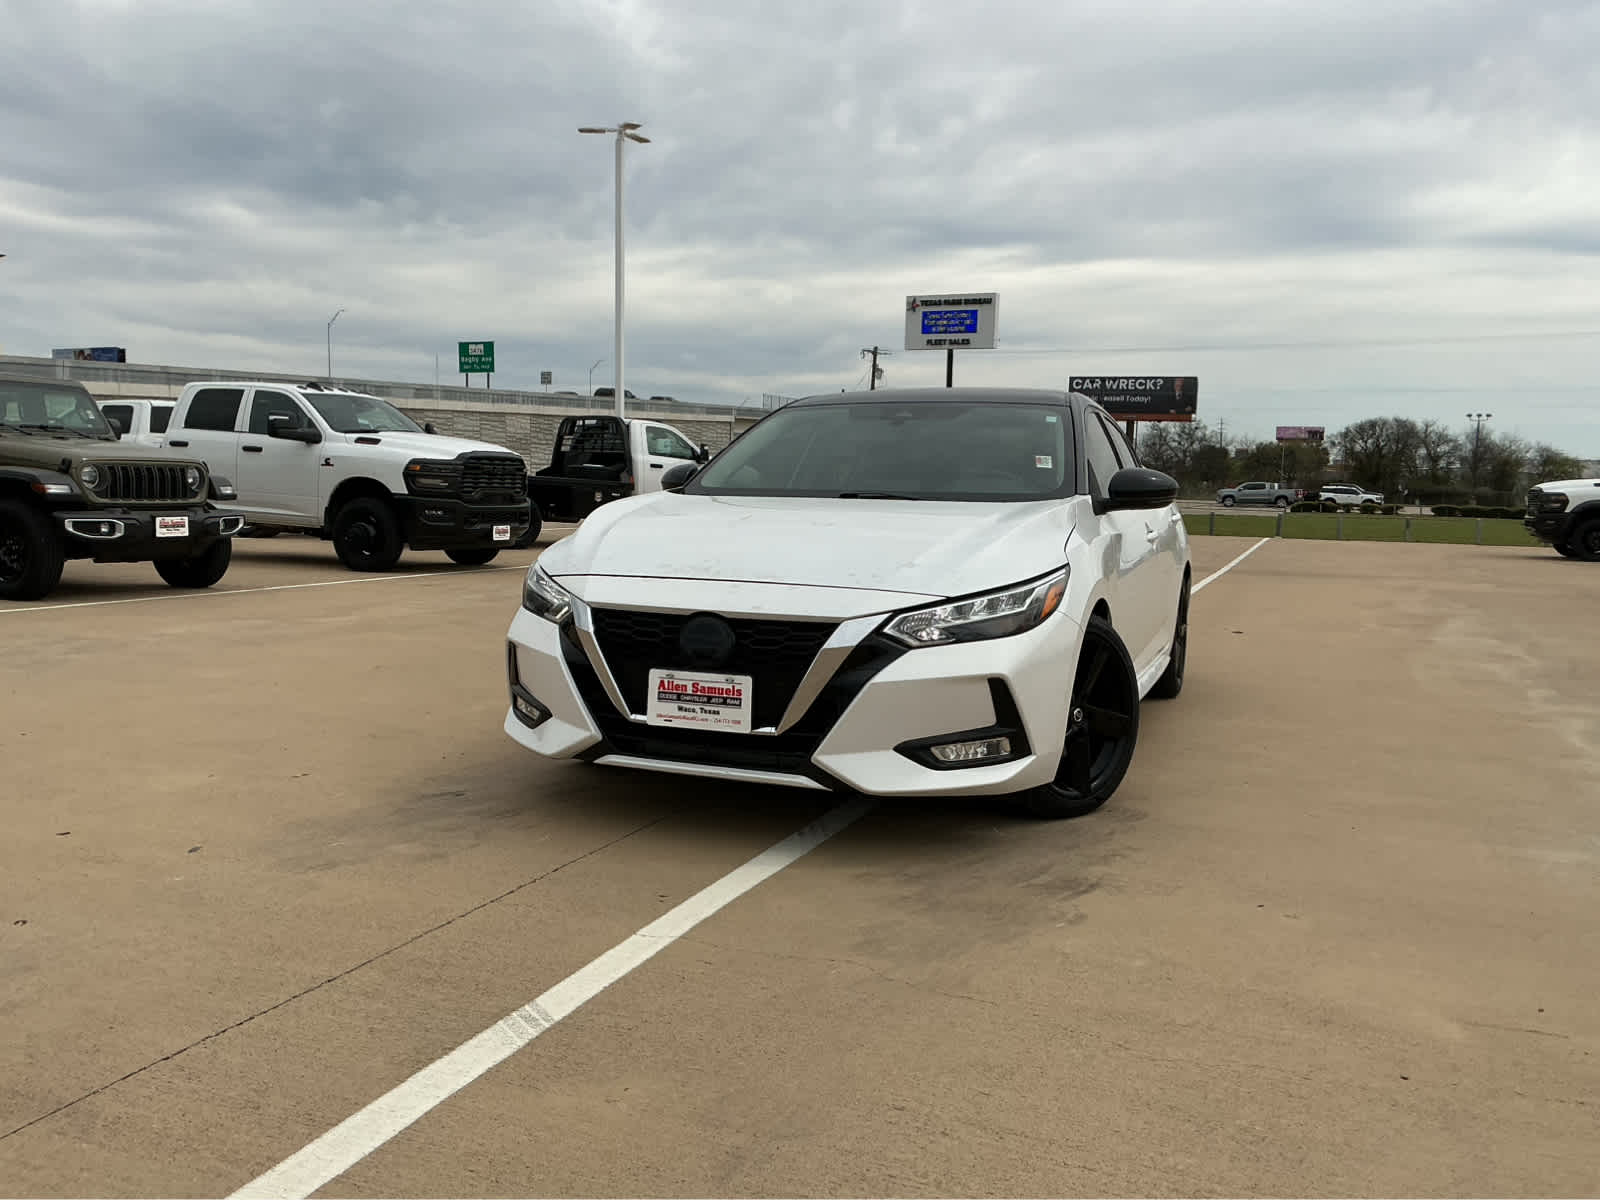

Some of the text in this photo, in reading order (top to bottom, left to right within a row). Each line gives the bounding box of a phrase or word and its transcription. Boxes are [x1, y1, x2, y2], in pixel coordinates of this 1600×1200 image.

[926, 338, 971, 346] FLEET SALES
[1072, 378, 1165, 390] CAR WRECK?
[658, 679, 742, 697] Allen Samuels
[677, 705, 721, 716] Waco, Texas
